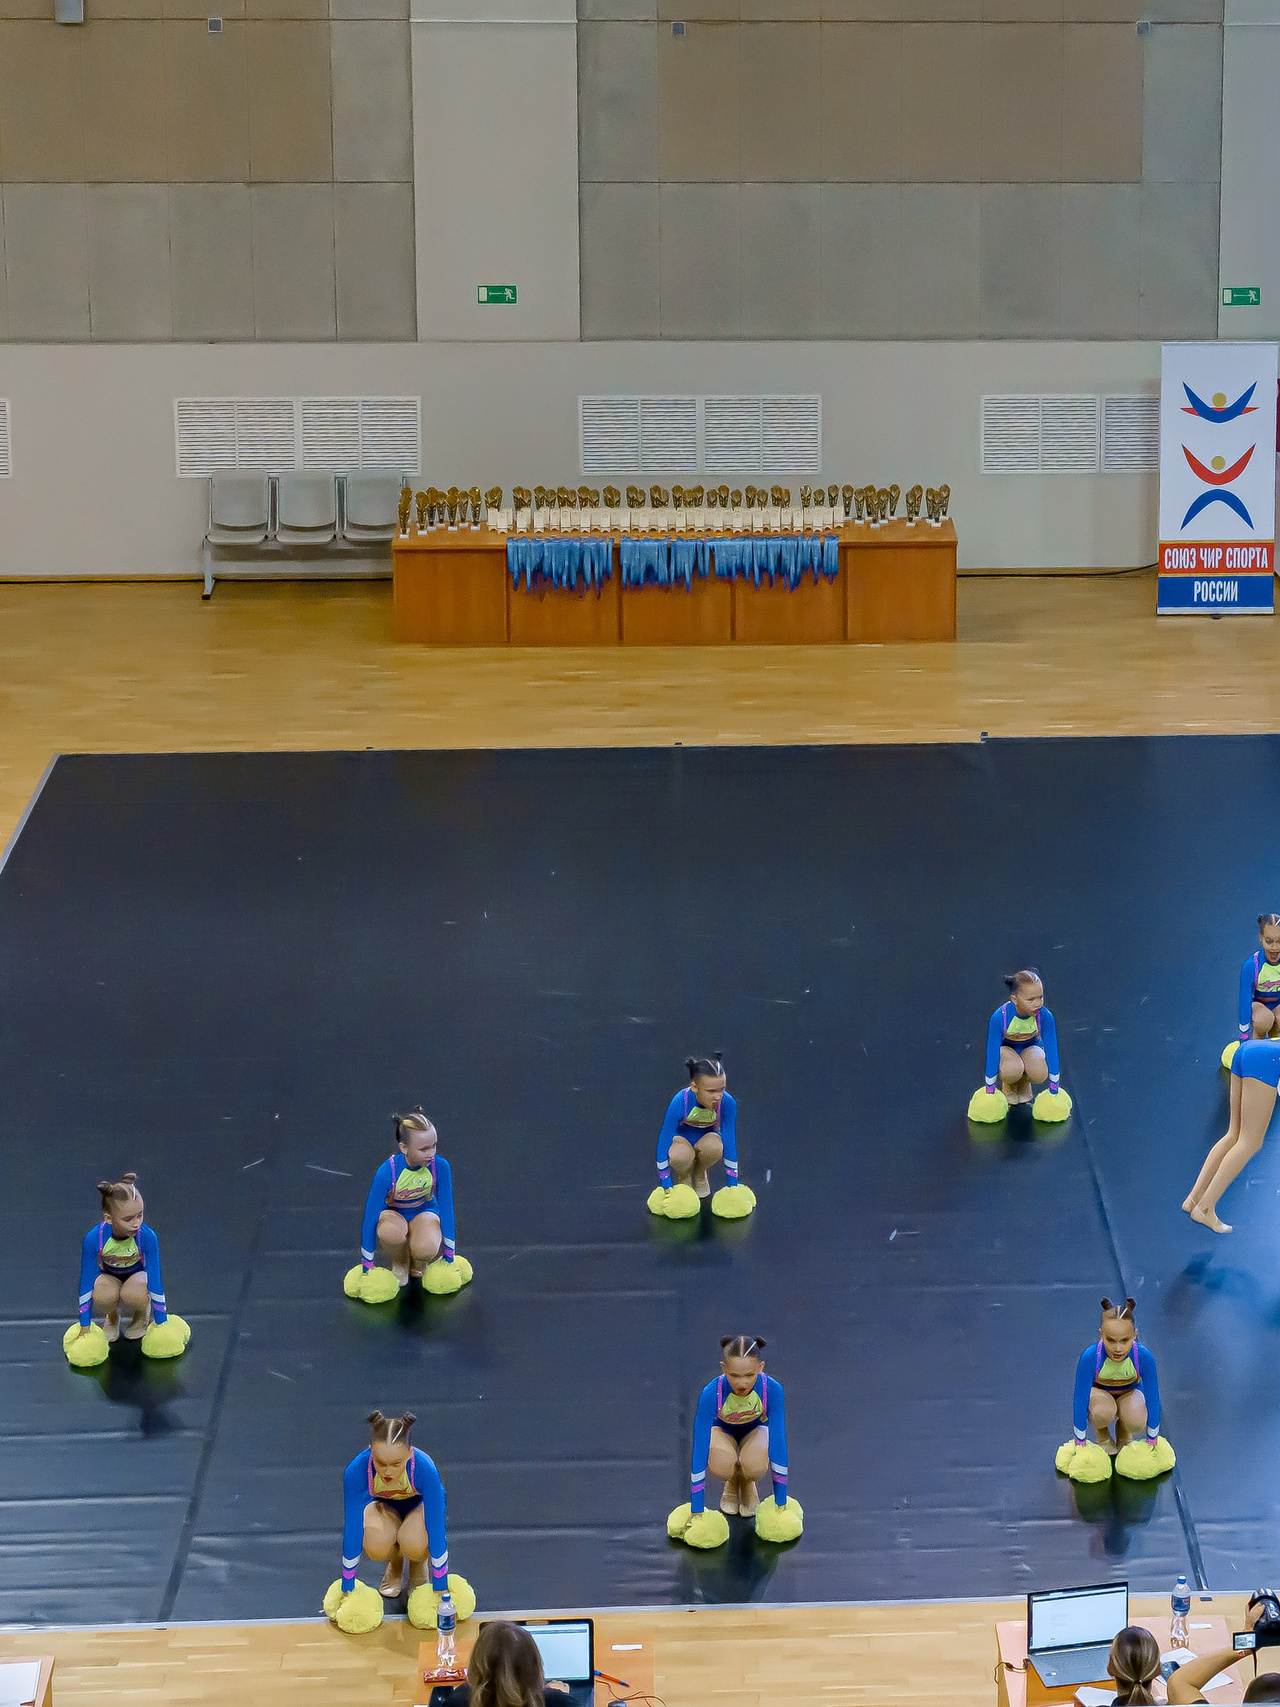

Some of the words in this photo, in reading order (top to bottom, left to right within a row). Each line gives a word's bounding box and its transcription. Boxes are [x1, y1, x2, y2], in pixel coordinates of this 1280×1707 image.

[1164, 548, 1196, 569] СОЮЗ
[1200, 548, 1222, 569] ЧИР
[1225, 547, 1268, 568] СПОРТА
[1193, 580, 1238, 602] РОССИИ
